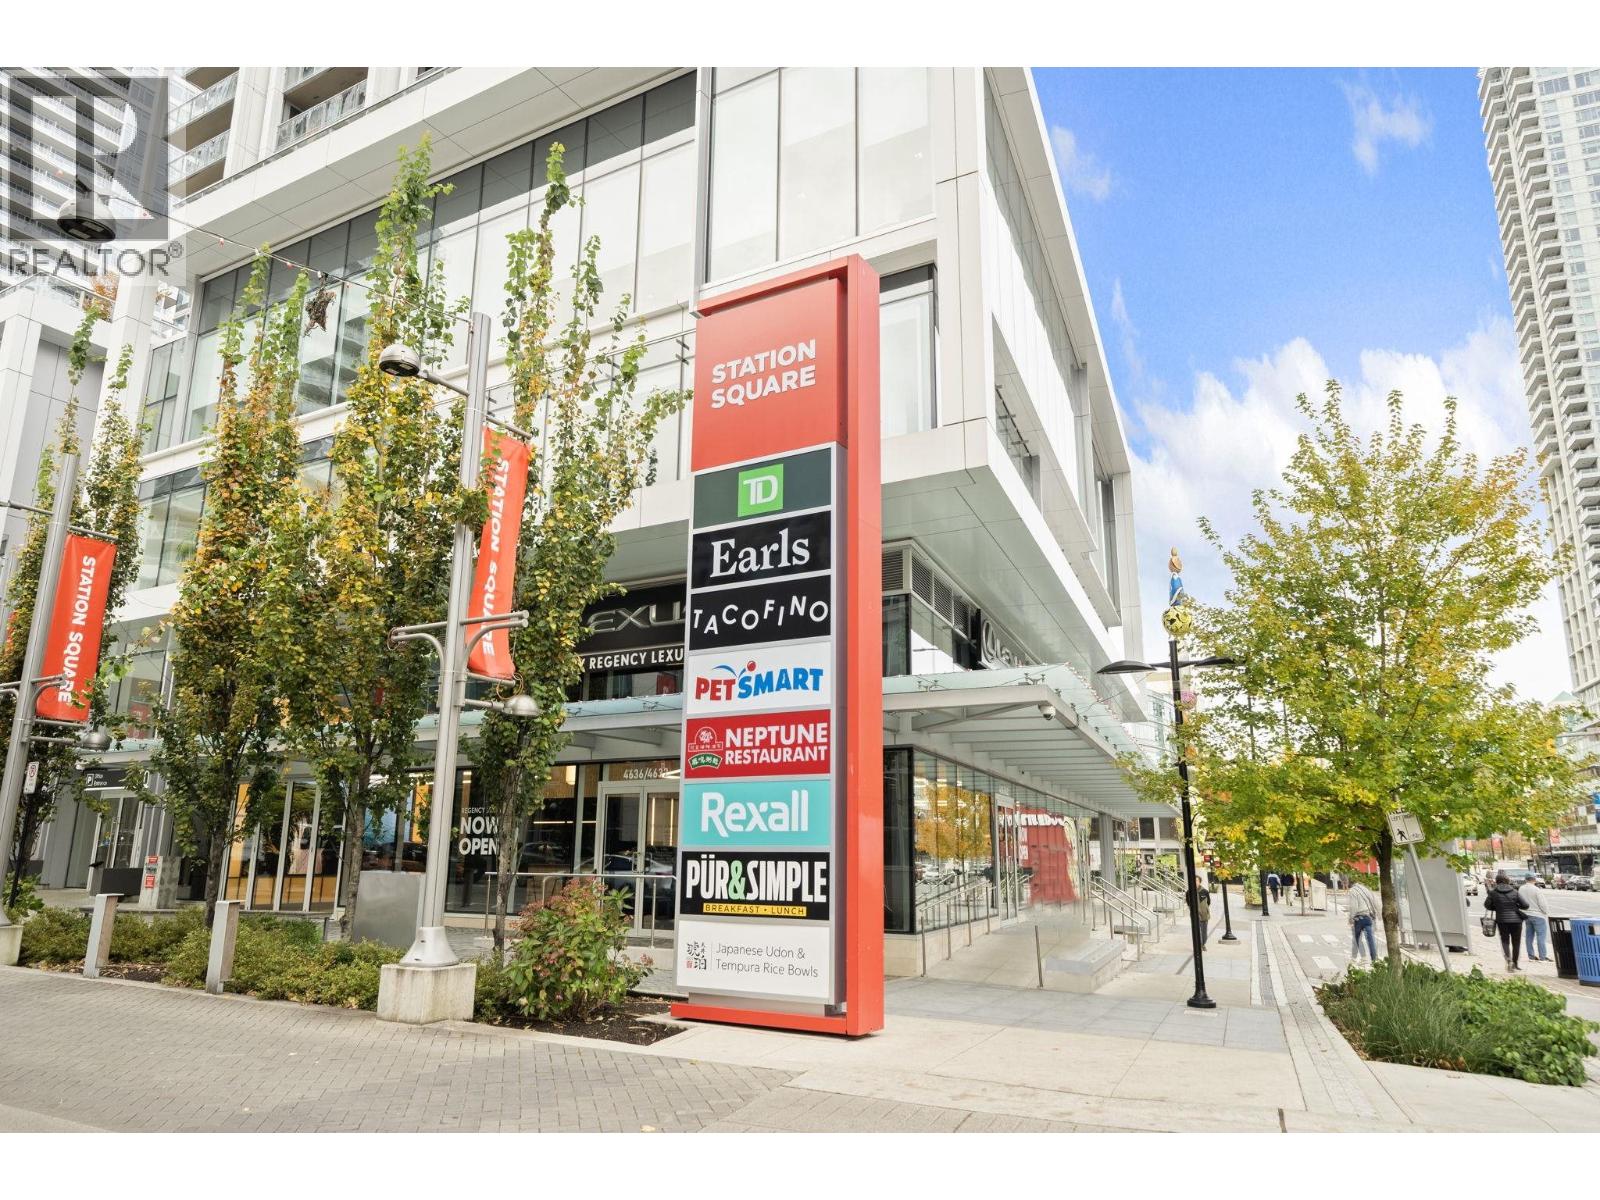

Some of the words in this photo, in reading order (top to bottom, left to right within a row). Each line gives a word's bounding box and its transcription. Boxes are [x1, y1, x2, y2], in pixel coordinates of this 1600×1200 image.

[712, 339, 816, 384] STATION
[711, 365, 816, 409] SQUARE
[490, 458, 510, 552] STATION
[743, 475, 779, 506] TD
[709, 527, 811, 578] Earls
[72, 555, 97, 626] STATION
[587, 601, 686, 634] EXU
[693, 595, 829, 635] TACOFINO
[58, 631, 84, 703] SQUARE
[589, 651, 648, 670] REGENCY
[651, 648, 685, 664] LEXU
[725, 722, 829, 748] NEPTUNE
[725, 745, 828, 766] RESTAURANT
[460, 816, 498, 835] NOW
[701, 789, 809, 838] Rexall
[459, 837, 499, 856] OPEN
[686, 853, 827, 903] PÜR&SIMPLE
[705, 904, 760, 914] BREAKFAST
[771, 906, 804, 915] LUNCH
[716, 942, 763, 956] Japanese
[766, 945, 794, 958] Udon
[797, 947, 806, 959] &
[716, 959, 760, 973] Tempura
[763, 962, 785, 975] Rice
[788, 963, 819, 978] Bowls
